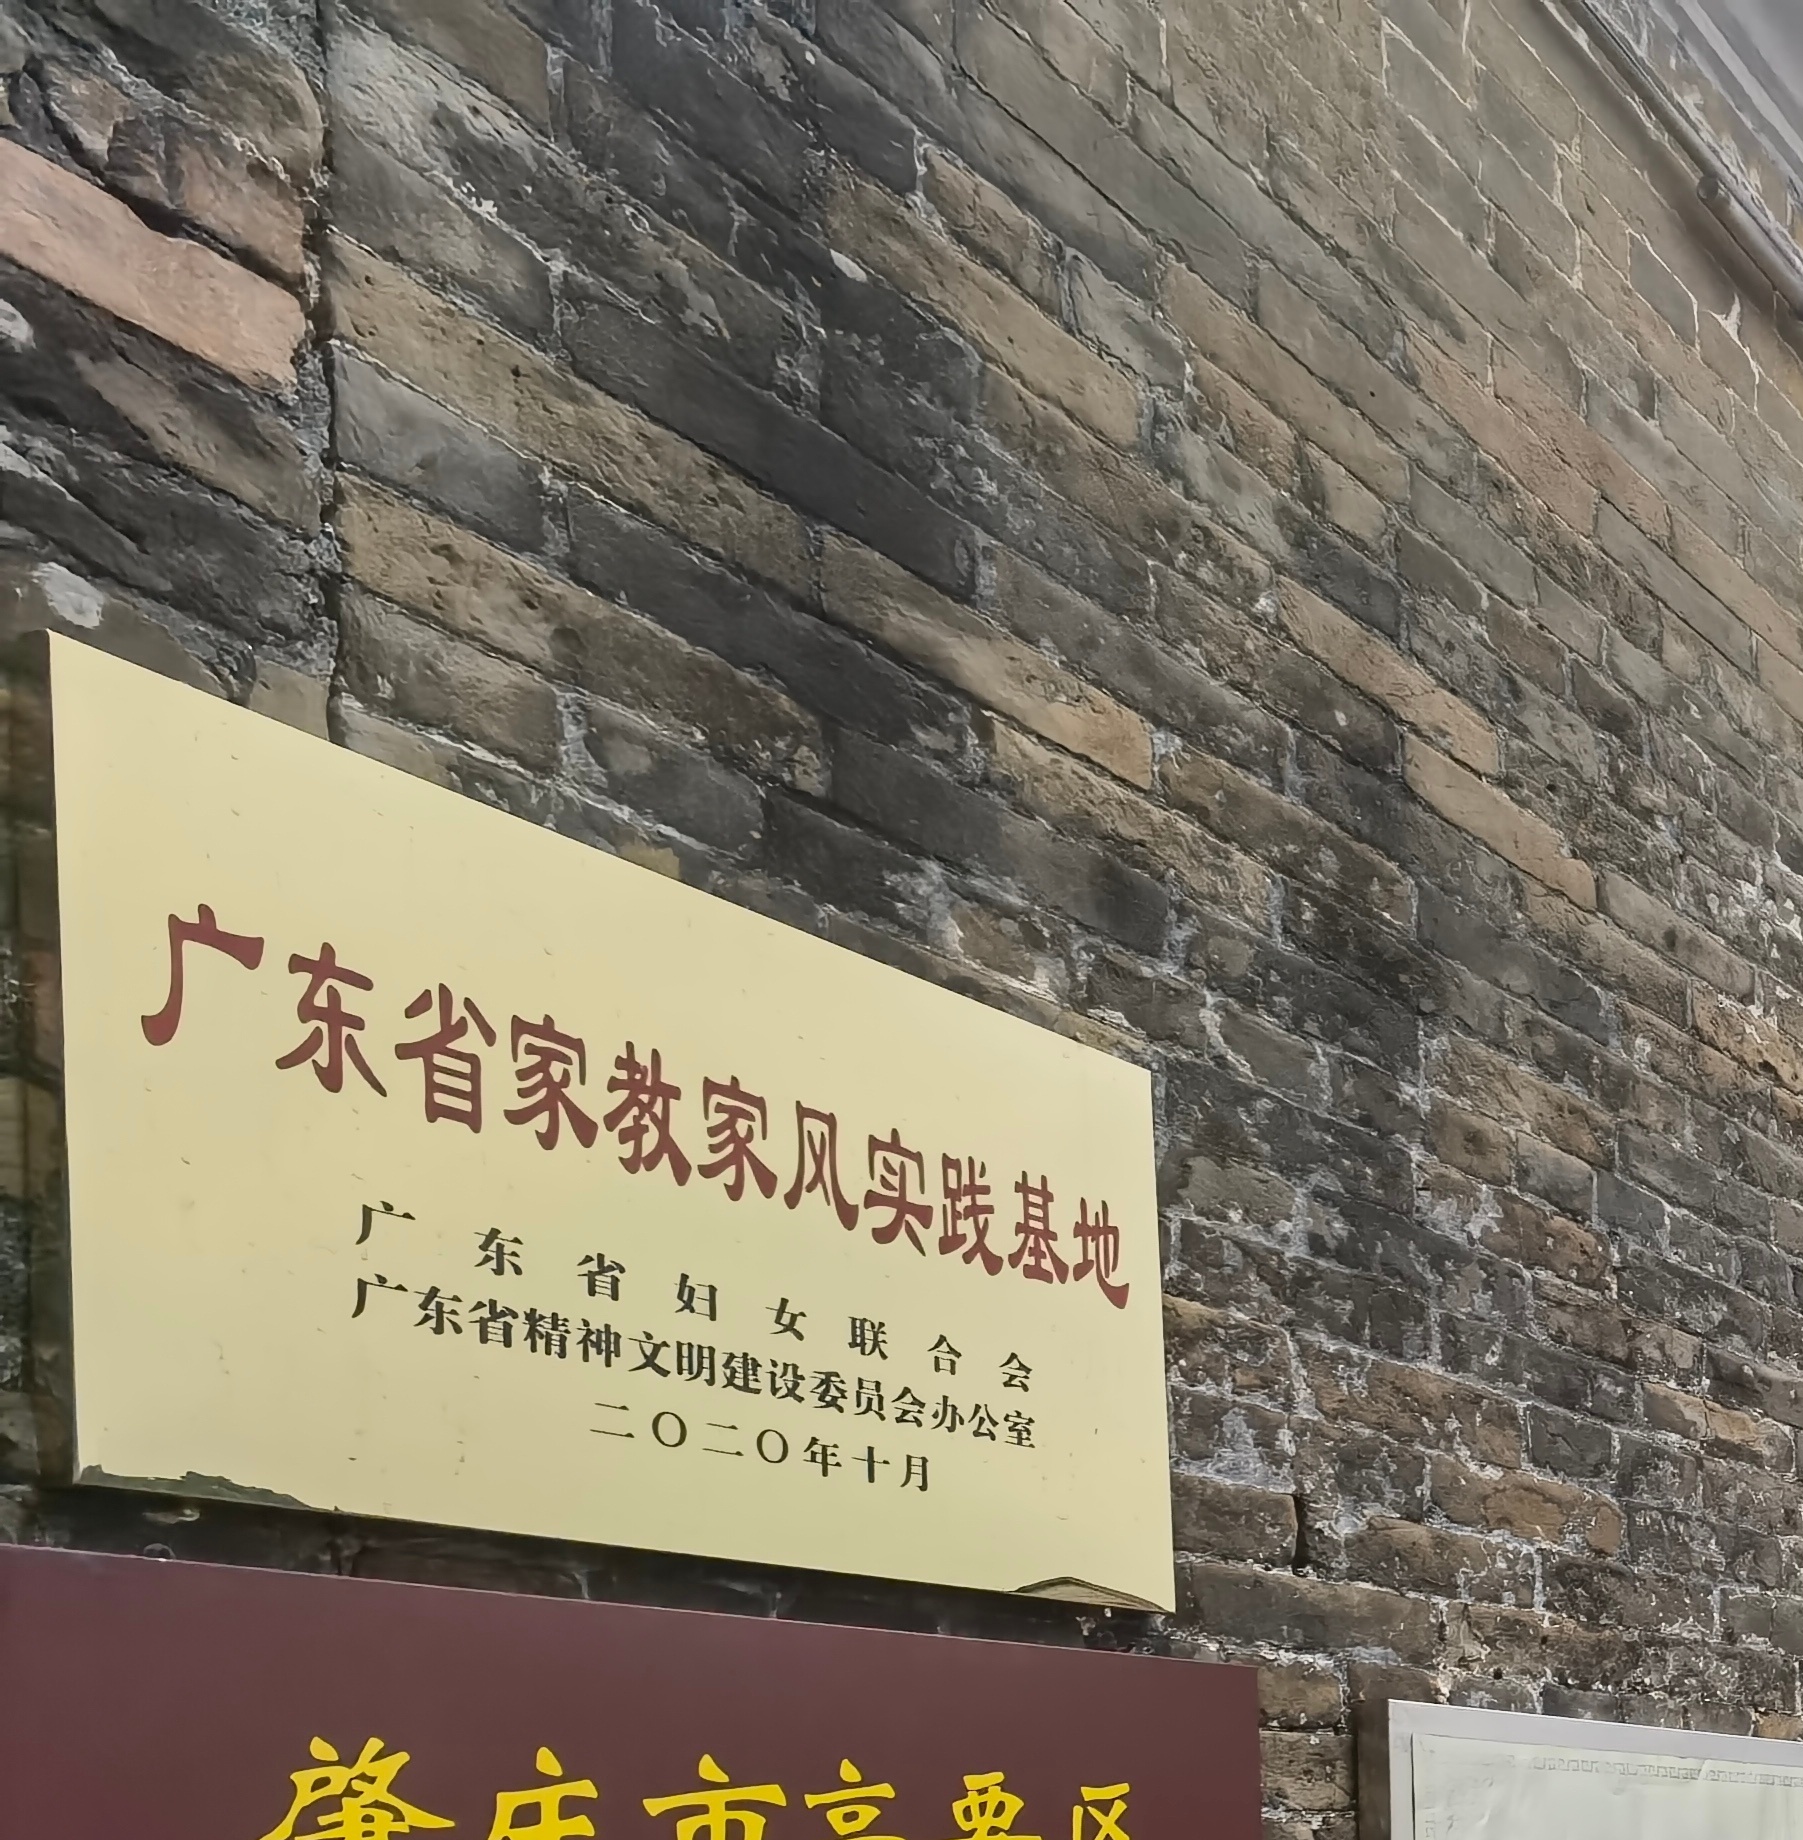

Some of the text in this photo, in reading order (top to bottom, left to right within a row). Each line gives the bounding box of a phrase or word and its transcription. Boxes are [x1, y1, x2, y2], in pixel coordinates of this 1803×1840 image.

[141, 903, 1129, 1308] 广东省家教家风实践基地
[351, 1272, 1037, 1450] 广东省精神文明建设委员会办公室
[354, 1200, 1033, 1393] 广东省妇女联合会
